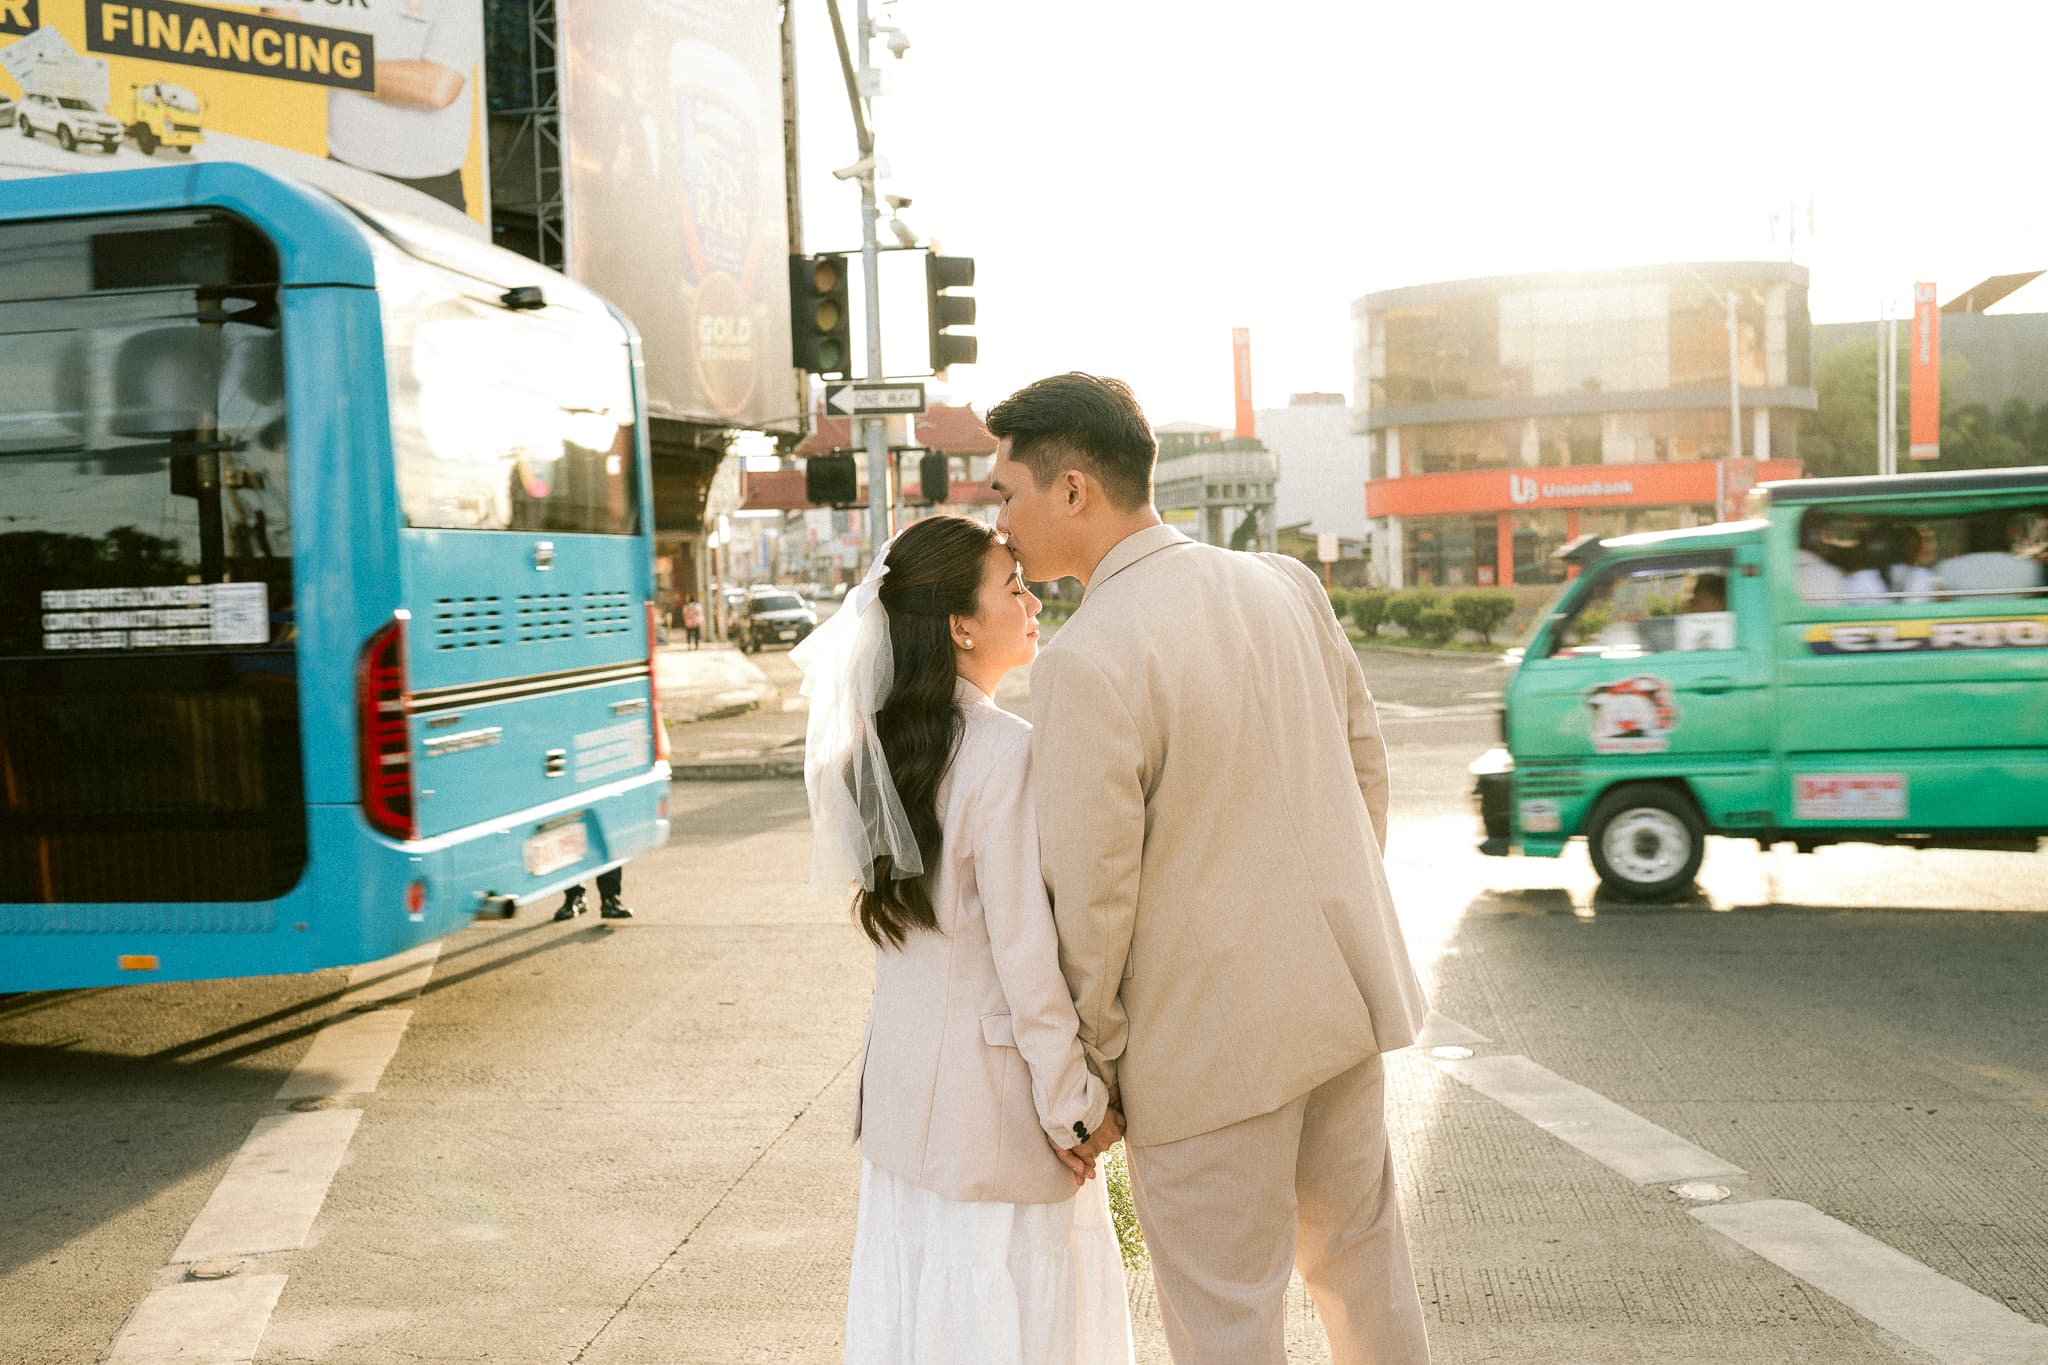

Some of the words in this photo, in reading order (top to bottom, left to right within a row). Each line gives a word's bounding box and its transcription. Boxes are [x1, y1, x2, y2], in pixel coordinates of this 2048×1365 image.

[101, 2, 363, 79] FINANCING
[699, 315, 752, 344] GOLD
[1543, 480, 1633, 497] UnionBank
[1832, 625, 1920, 652] EL
